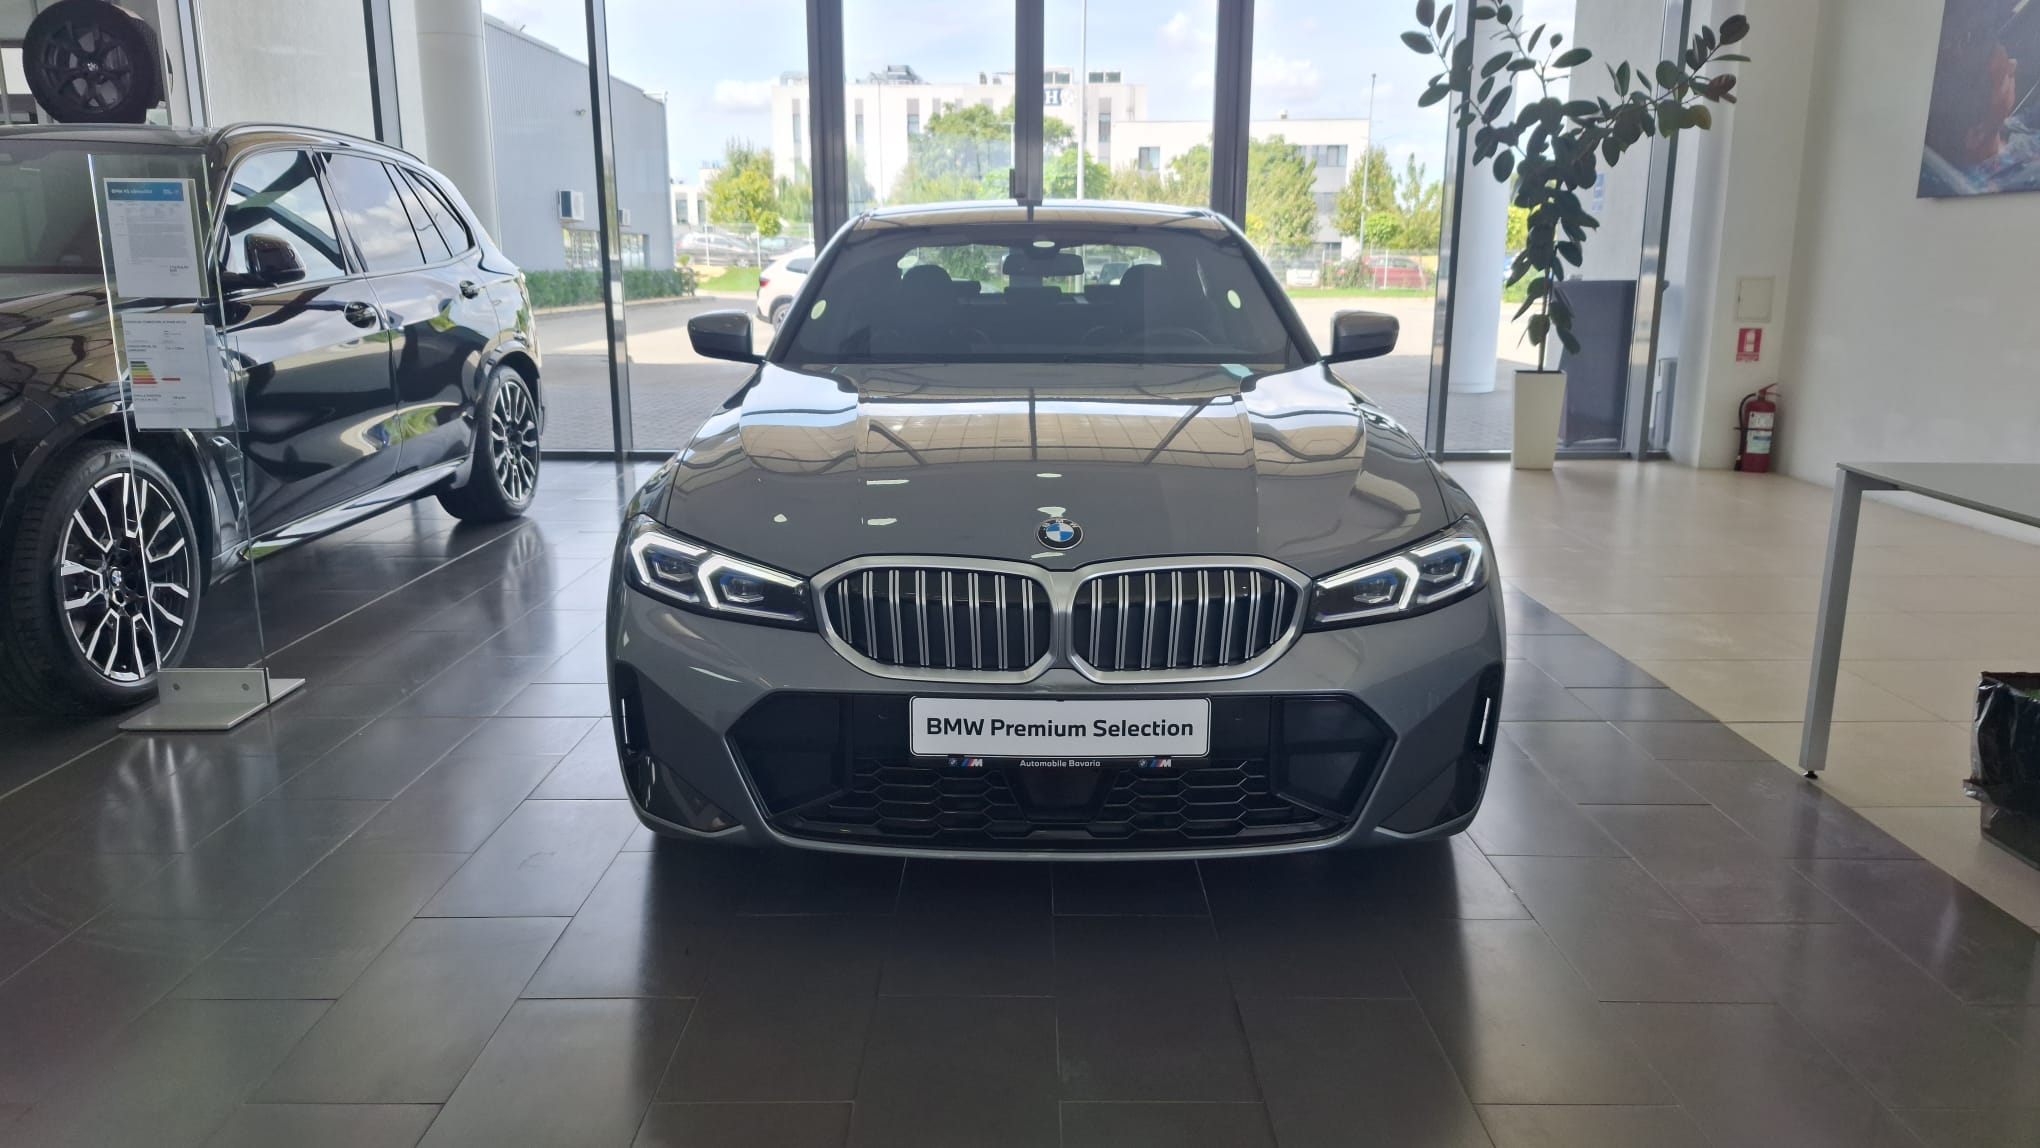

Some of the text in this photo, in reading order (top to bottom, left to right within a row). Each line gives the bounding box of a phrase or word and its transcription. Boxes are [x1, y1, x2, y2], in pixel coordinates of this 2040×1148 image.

[927, 718, 1193, 737] BMW Premium Selection
[1019, 759, 1101, 767] Automobile Bavaria
